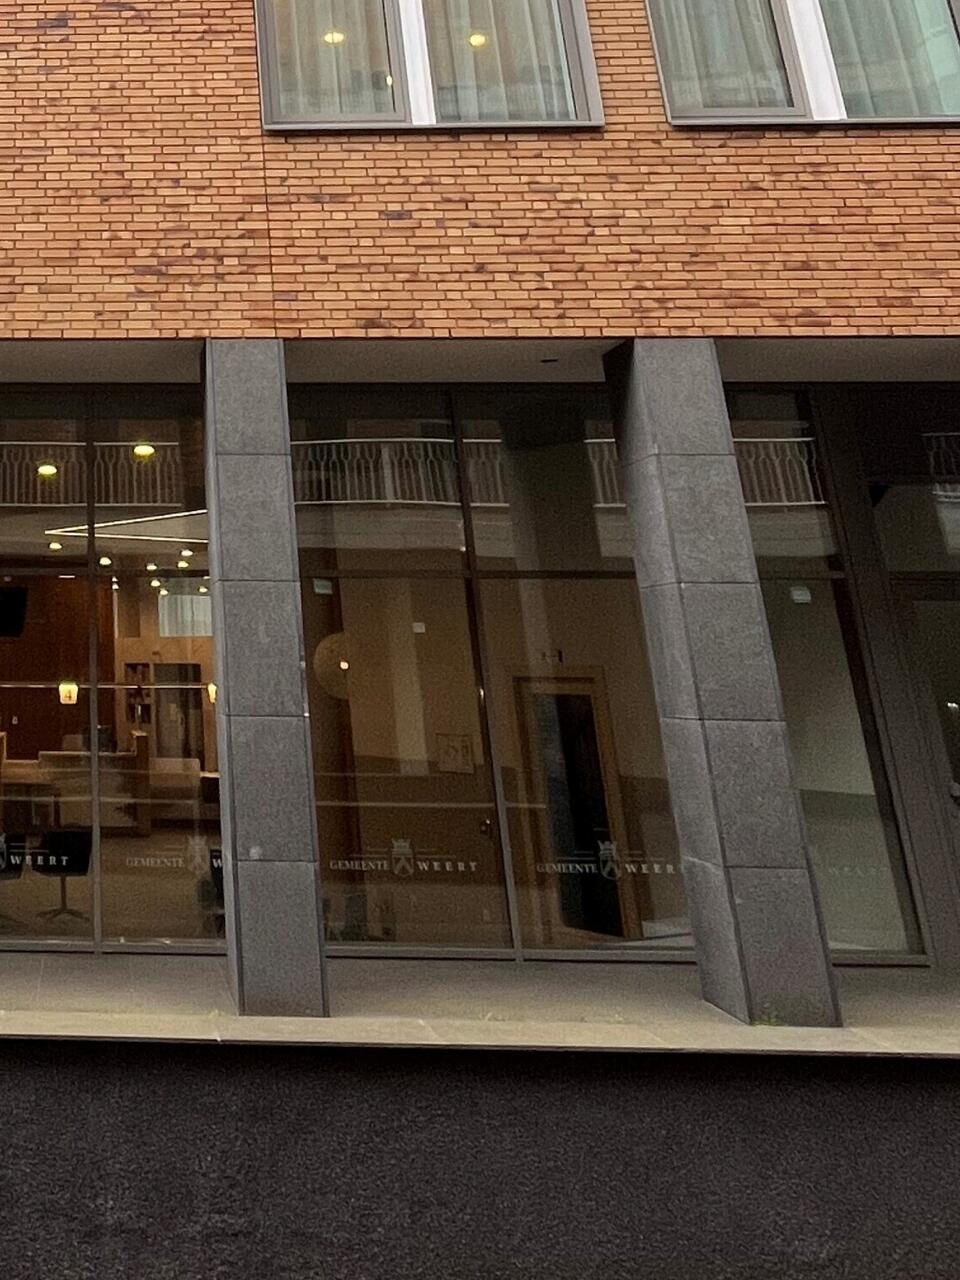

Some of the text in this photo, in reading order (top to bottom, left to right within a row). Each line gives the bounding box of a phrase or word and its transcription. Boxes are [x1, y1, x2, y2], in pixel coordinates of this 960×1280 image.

[64, 689, 73, 701] 4
[9, 854, 69, 867] WEERT
[125, 857, 185, 868] GEMEENTE
[329, 859, 478, 872] GEMEENTE WEERT
[535, 863, 597, 874] GEMEENTE
